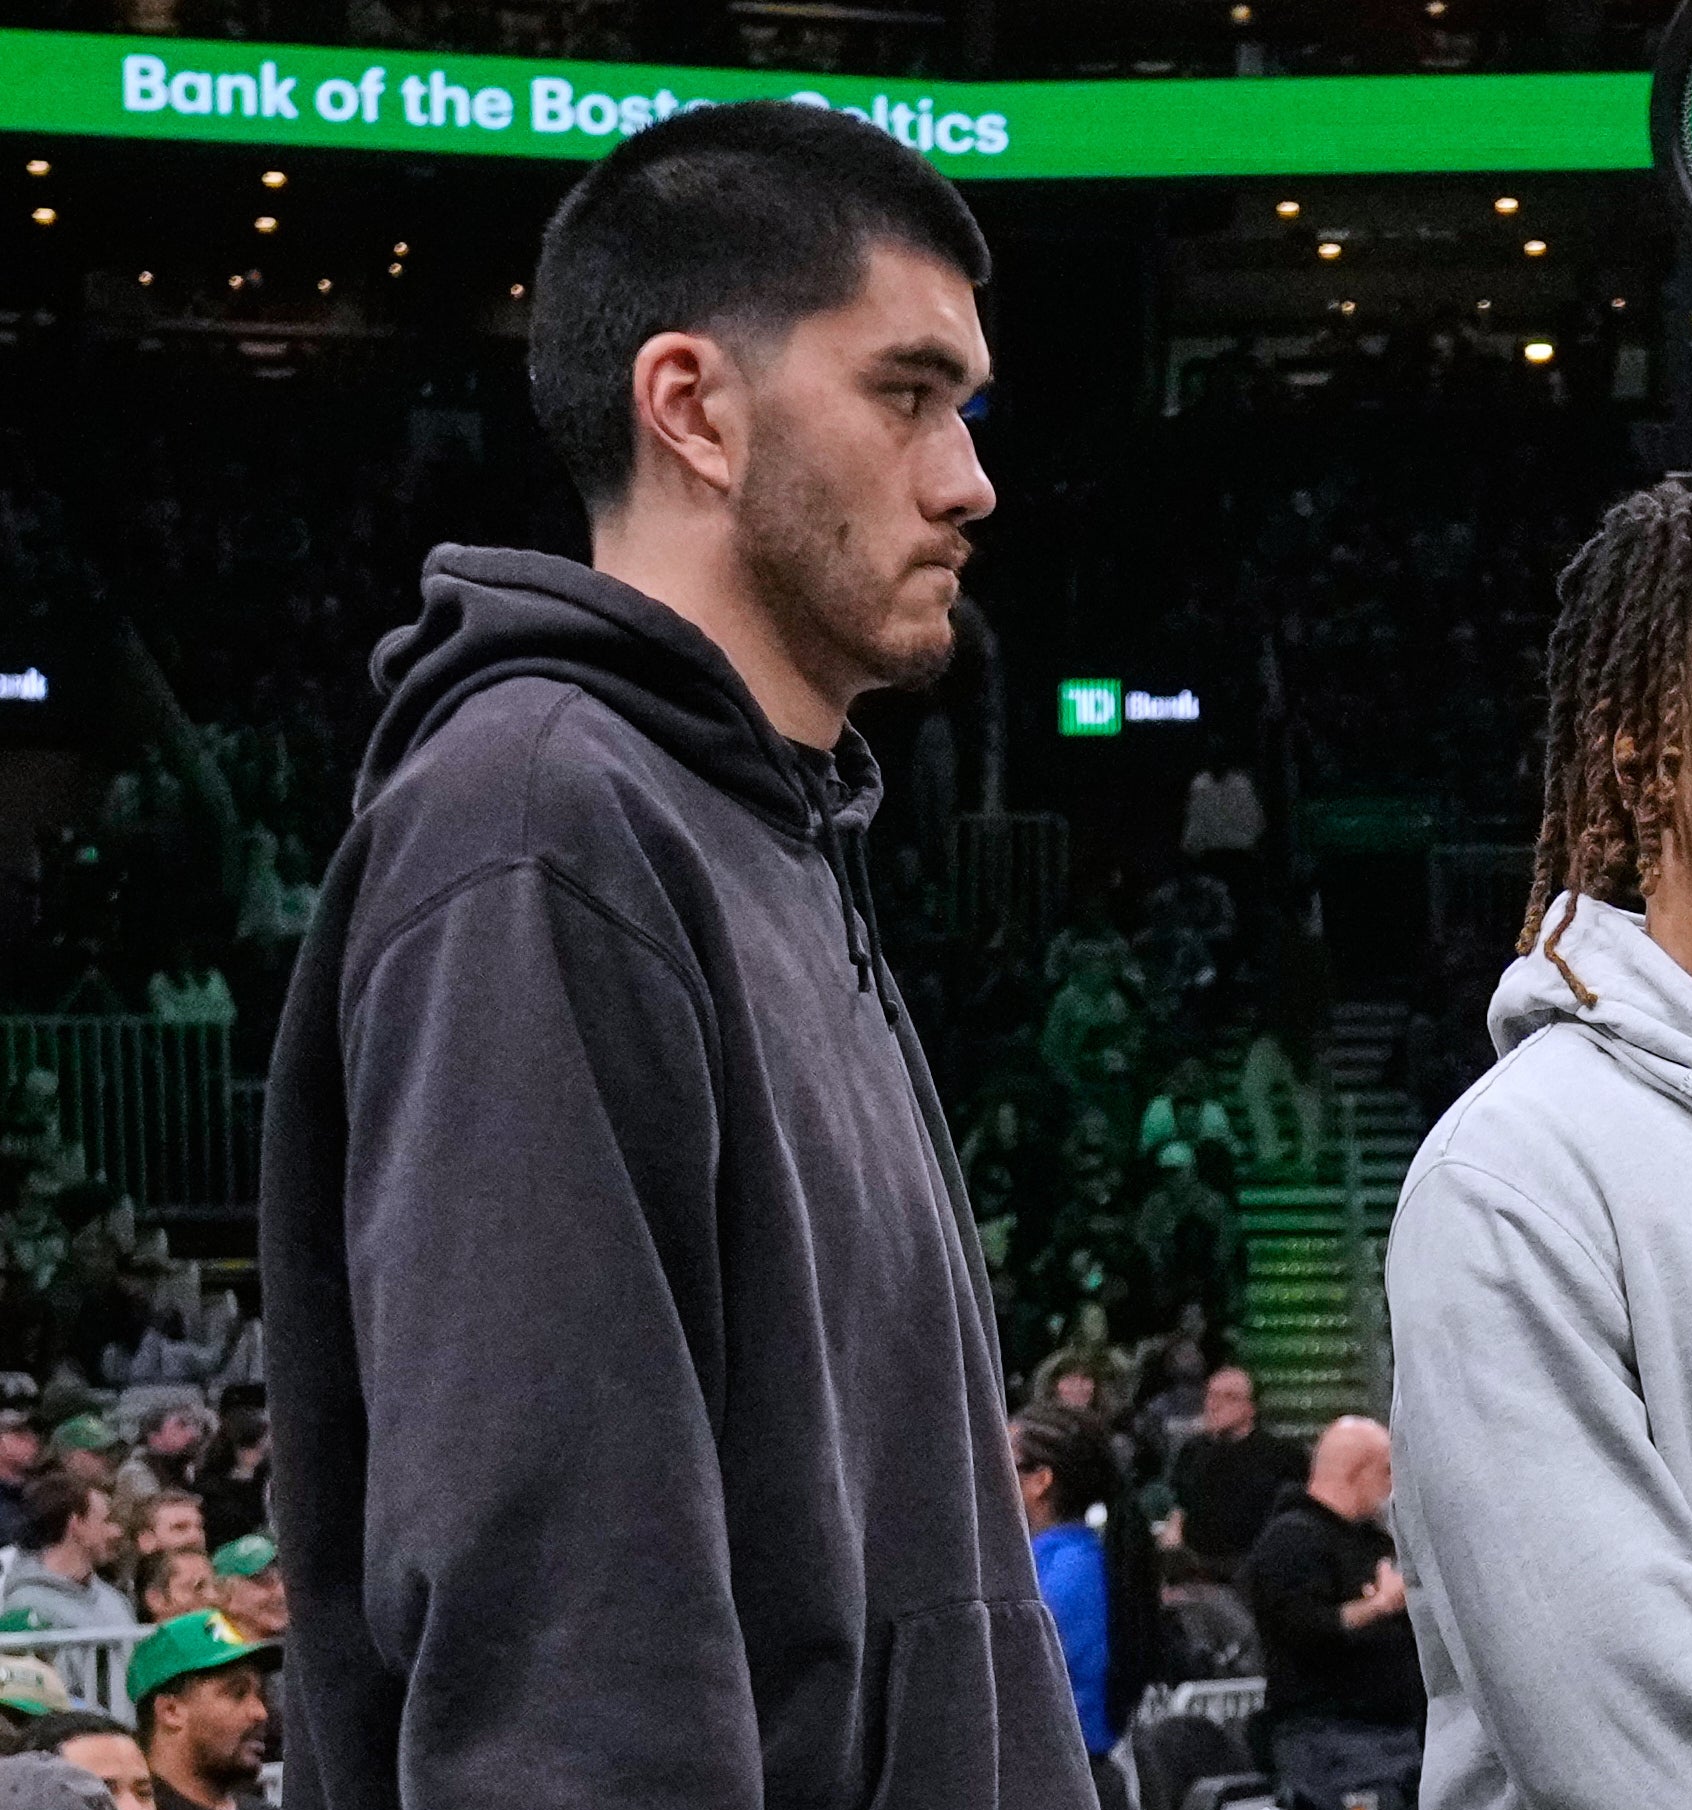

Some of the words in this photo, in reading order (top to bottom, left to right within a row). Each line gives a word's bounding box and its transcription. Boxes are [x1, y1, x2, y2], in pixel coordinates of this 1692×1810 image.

[122, 54, 299, 120] Bank
[315, 66, 387, 124] of
[401, 70, 515, 130] the
[530, 76, 717, 136] Bost
[790, 91, 1010, 155] ltics
